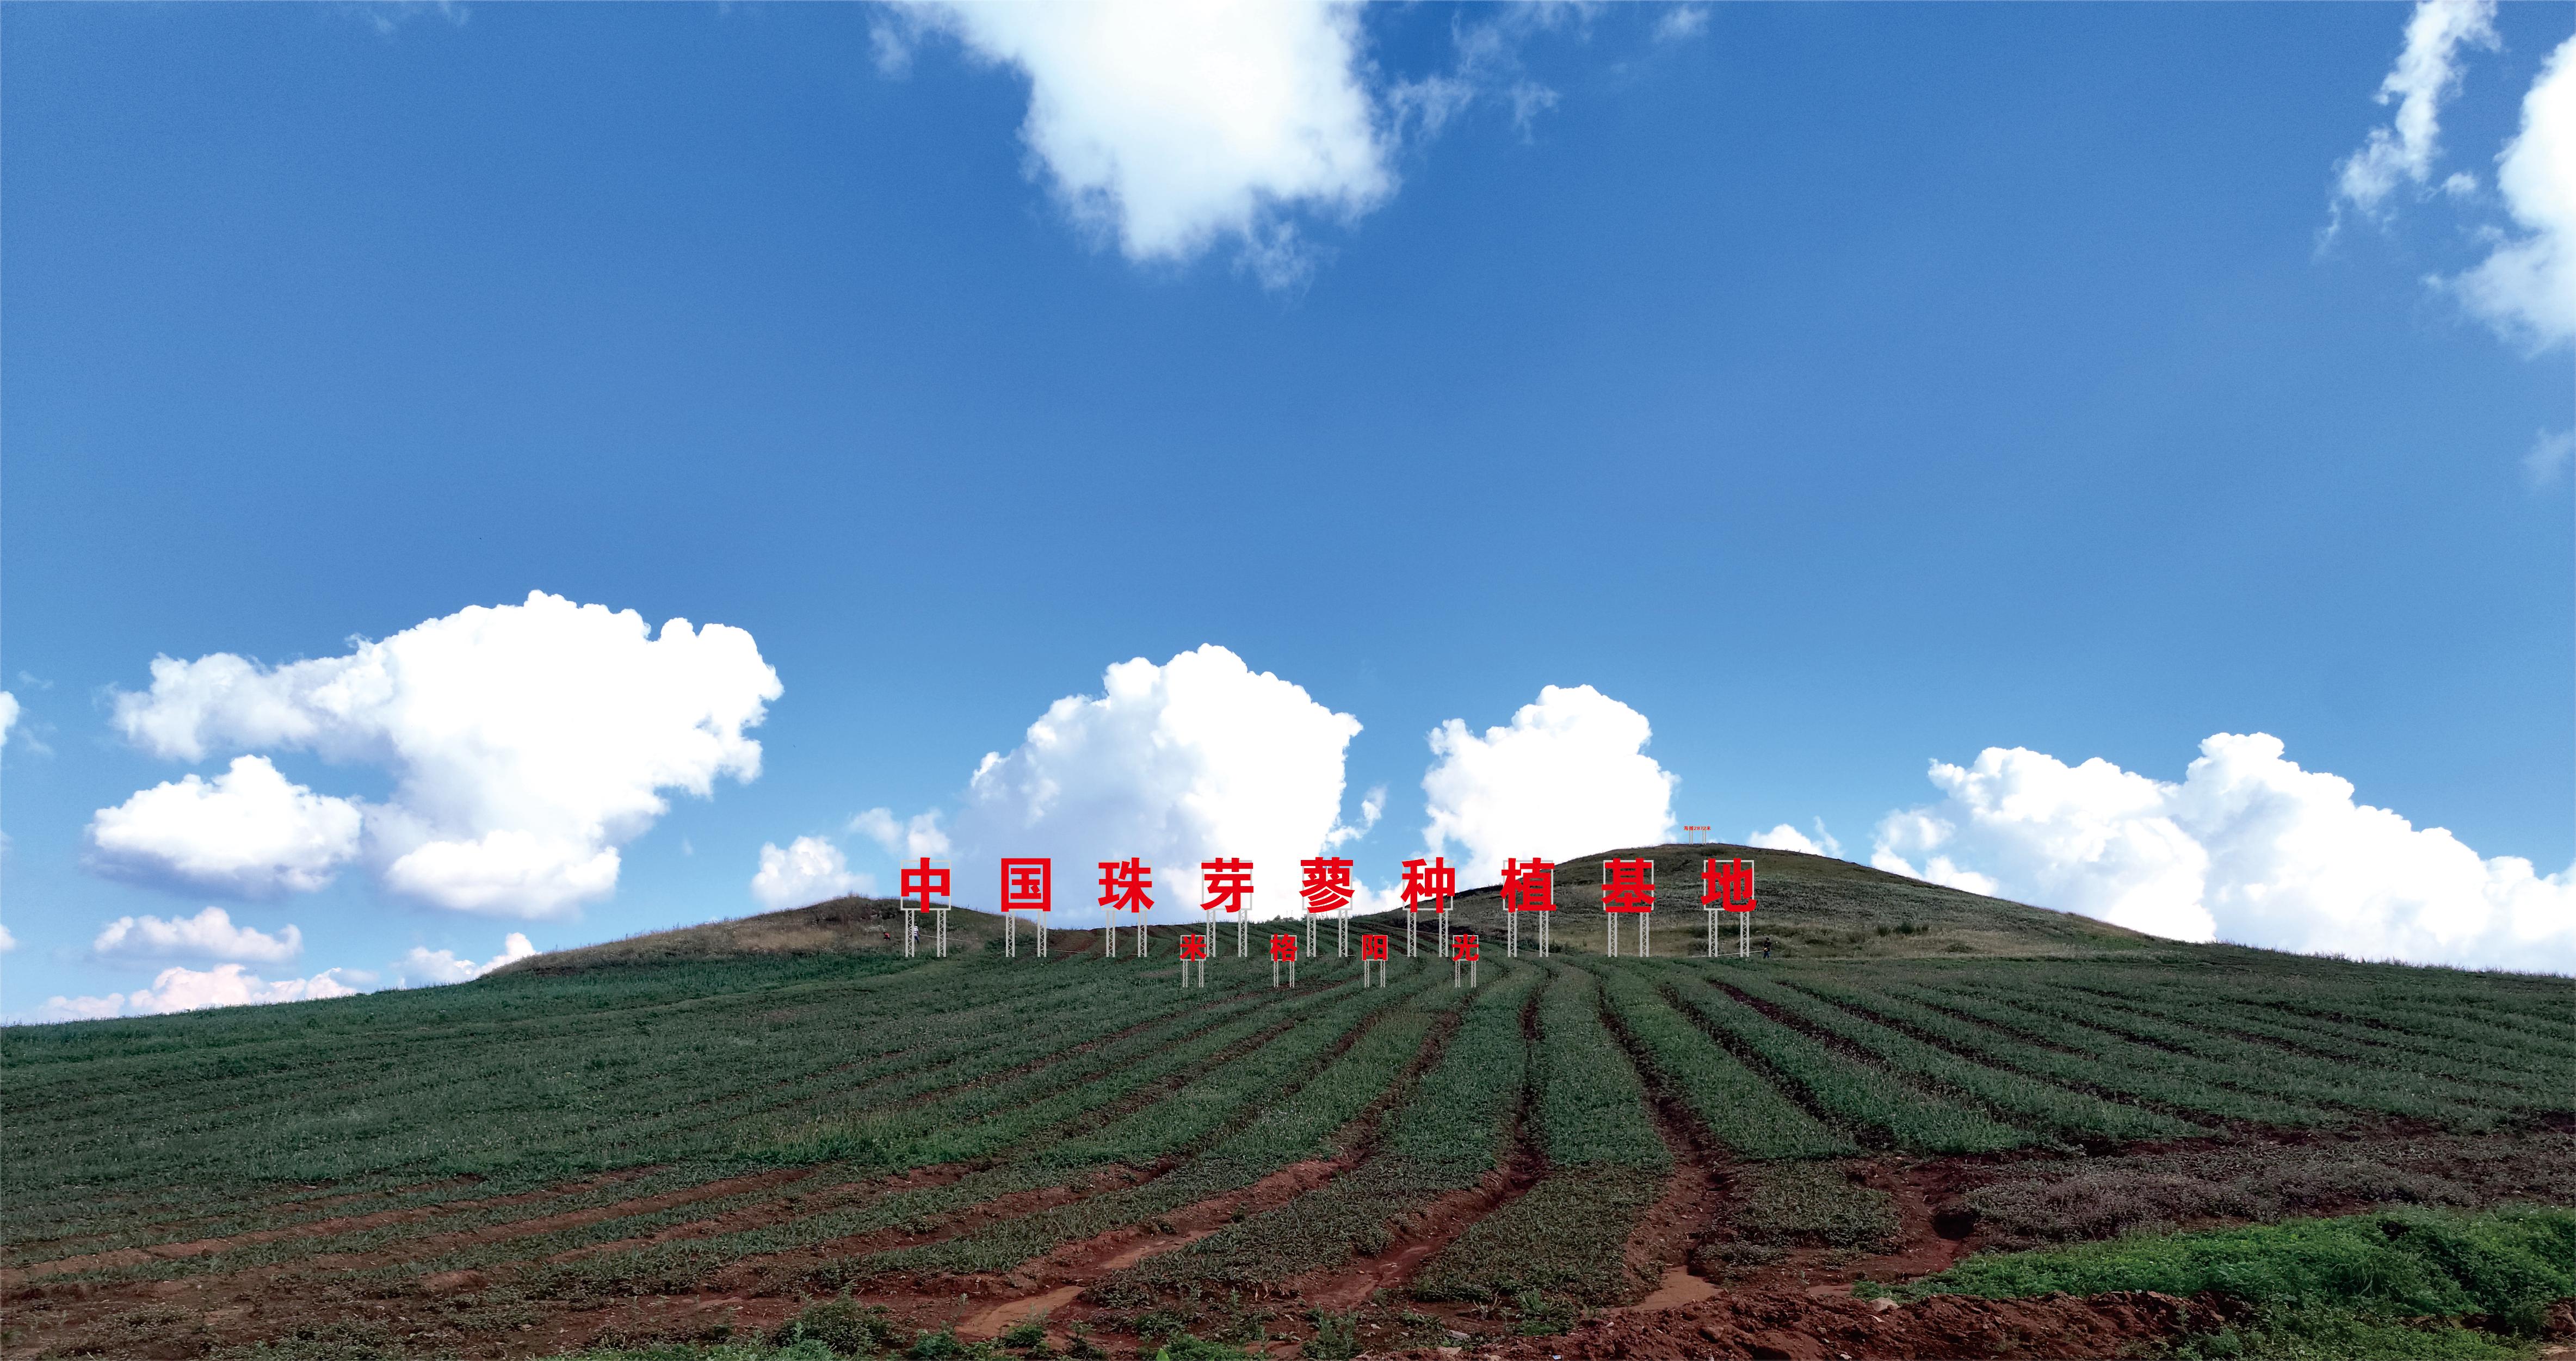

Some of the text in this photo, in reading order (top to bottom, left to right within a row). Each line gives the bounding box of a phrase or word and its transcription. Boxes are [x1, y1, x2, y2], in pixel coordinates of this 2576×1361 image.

[900, 857, 1757, 913] 中国珠芽蓼种植基地
[1179, 933, 1479, 962] 米格阳光
